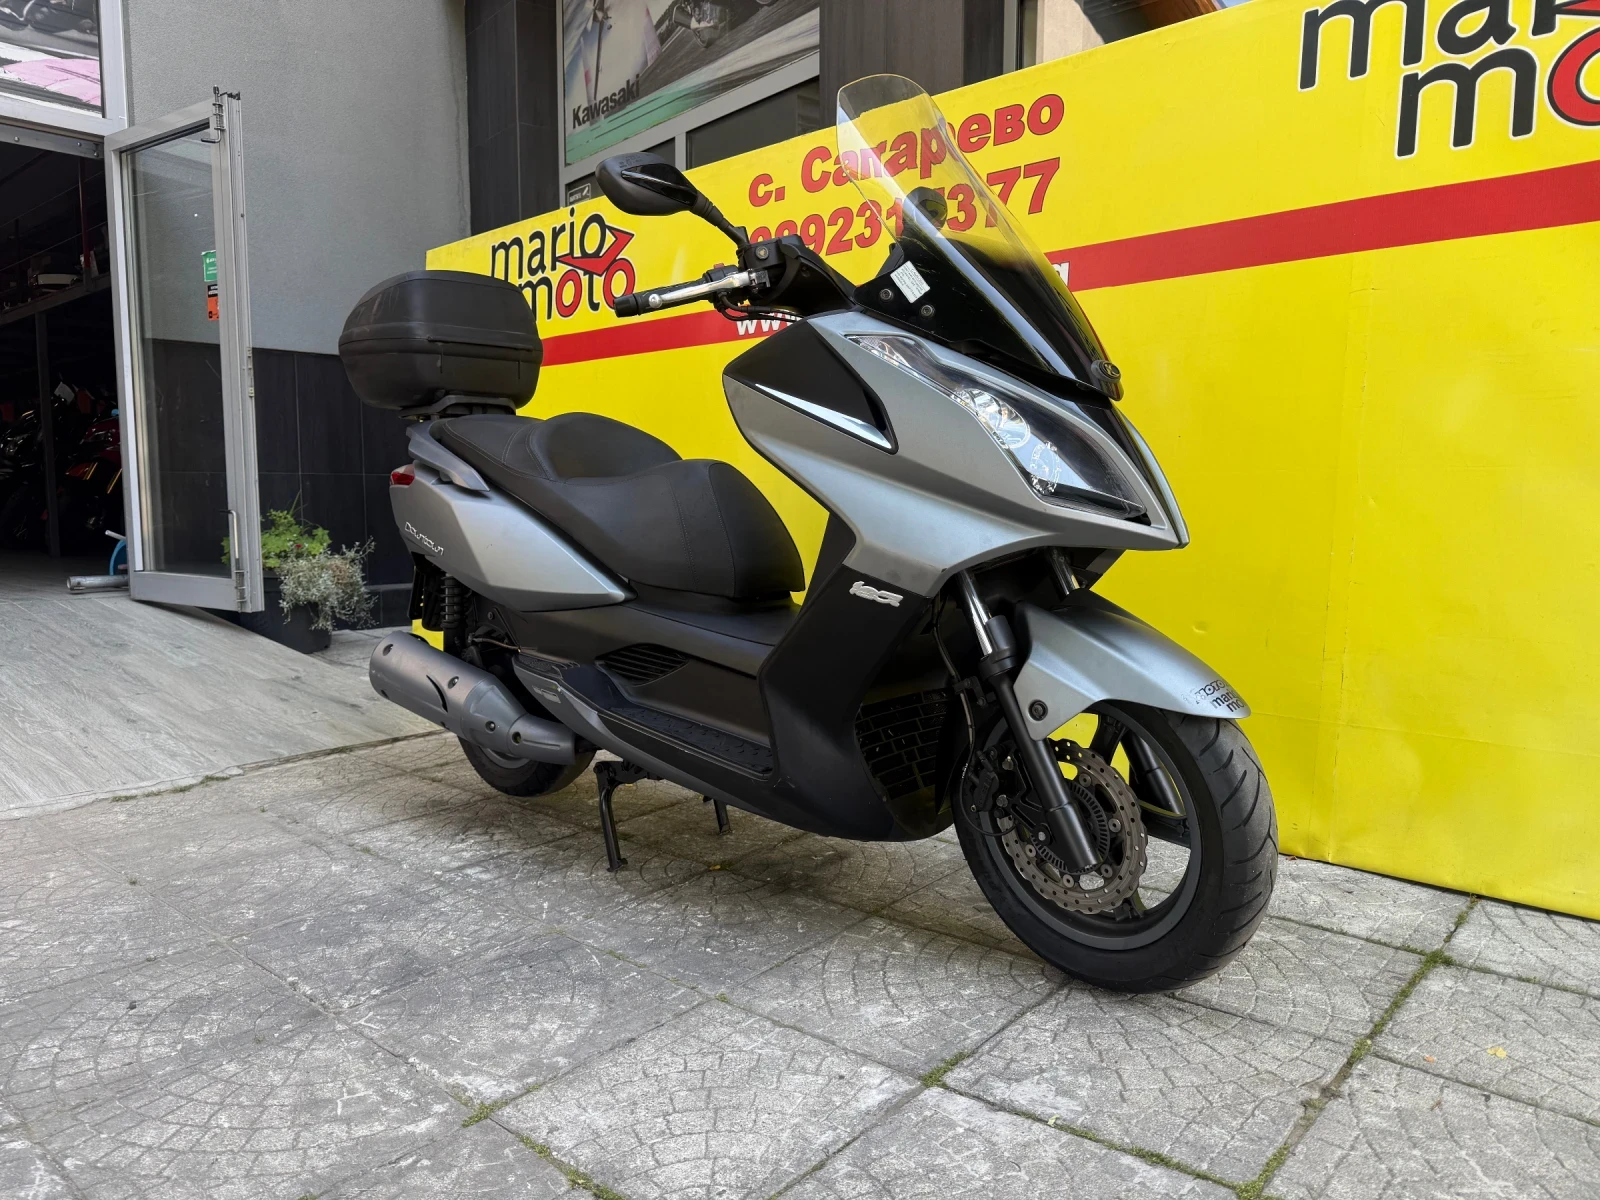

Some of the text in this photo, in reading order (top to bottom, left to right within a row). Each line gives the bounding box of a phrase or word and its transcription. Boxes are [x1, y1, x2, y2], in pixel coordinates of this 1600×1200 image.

[573, 74, 640, 130] Kawasaki
[749, 173, 786, 207] с.
[491, 207, 607, 282] mario
[518, 257, 636, 321] moto
